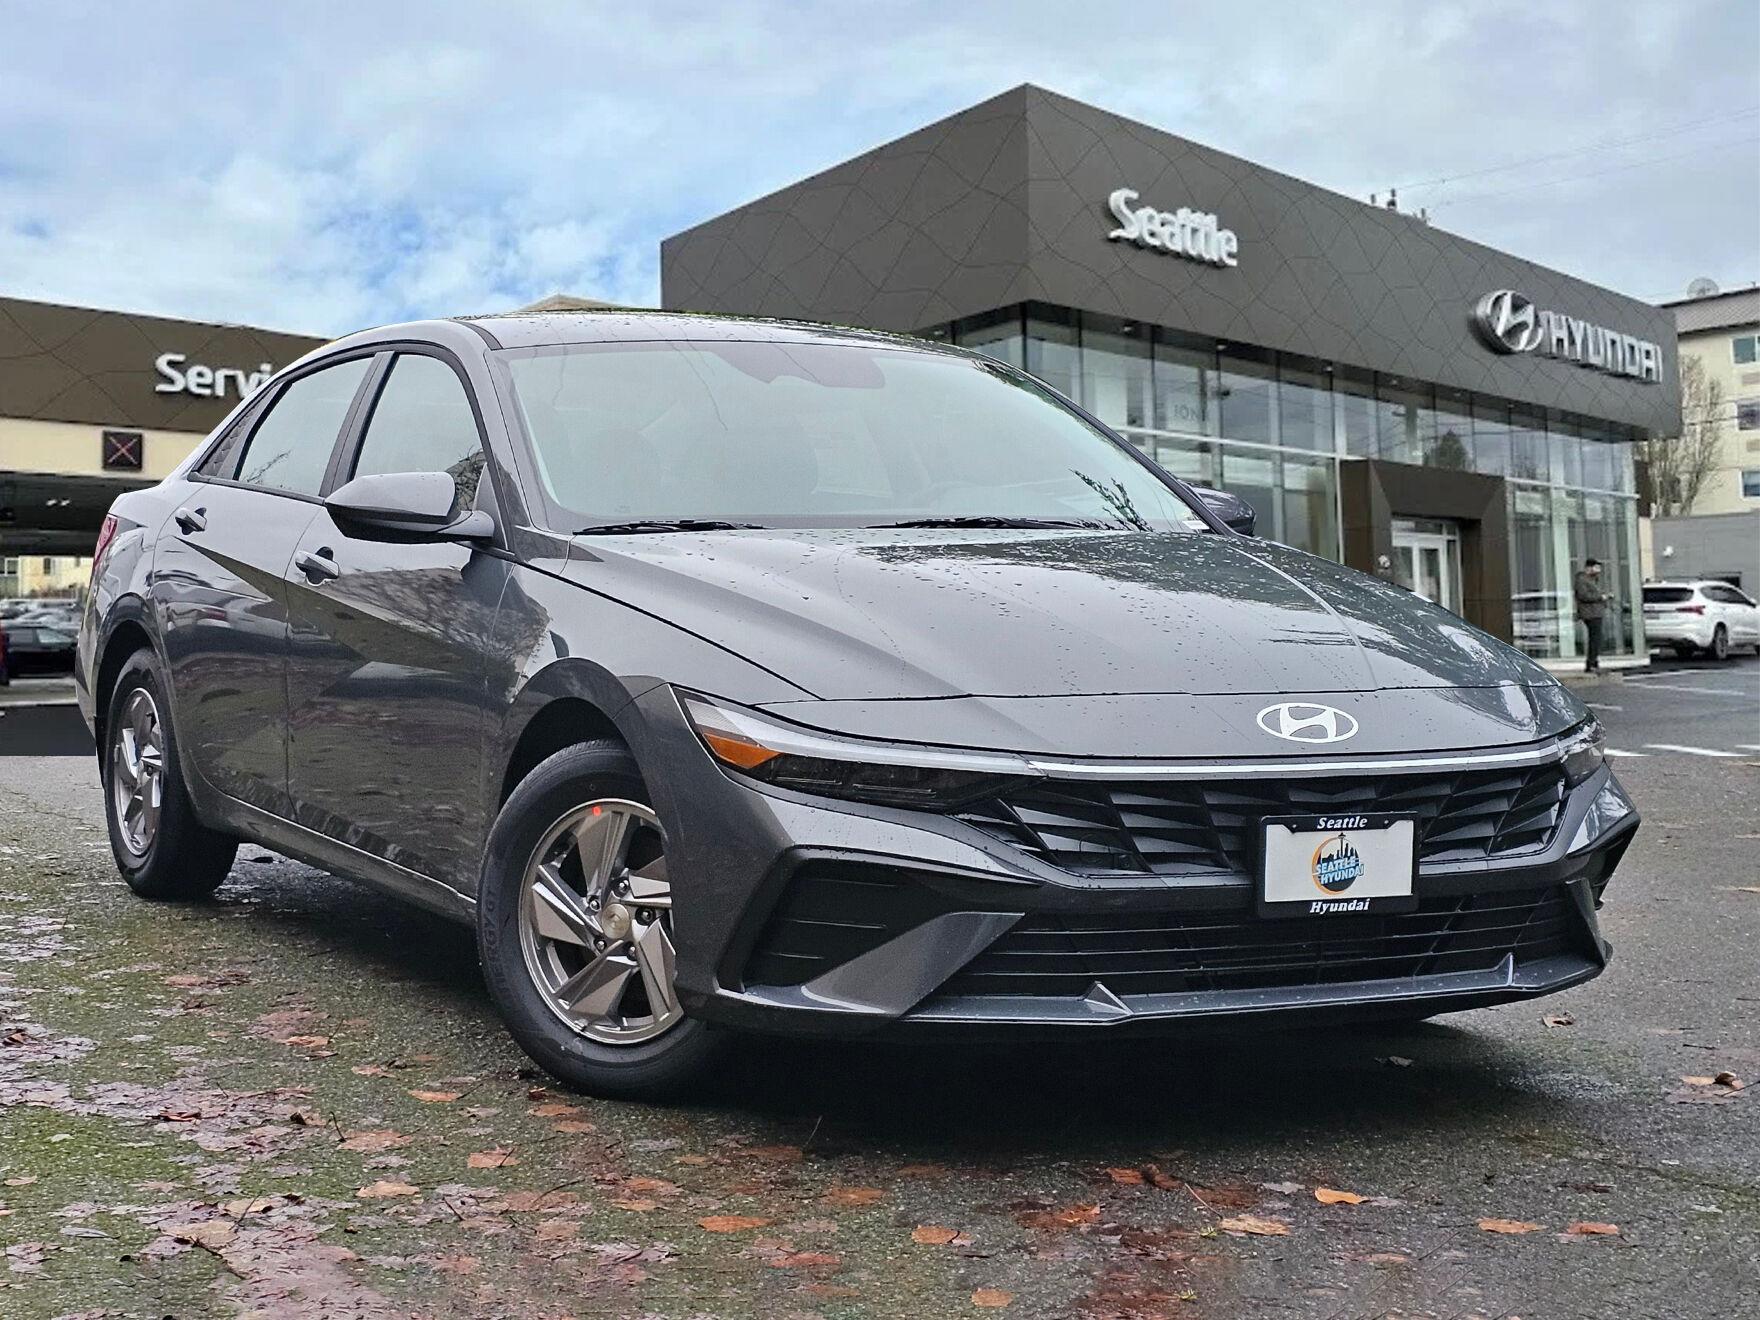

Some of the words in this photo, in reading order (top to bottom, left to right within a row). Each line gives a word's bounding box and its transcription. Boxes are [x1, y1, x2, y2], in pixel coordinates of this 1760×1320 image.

[1109, 188, 1238, 267] Seattle
[1538, 311, 1663, 383] HYUNDAI
[1317, 816, 1368, 830] Seattle
[1316, 856, 1357, 875] SEATTLE
[1320, 864, 1364, 885] HYUNDAI
[1309, 899, 1371, 914] Hyundai
